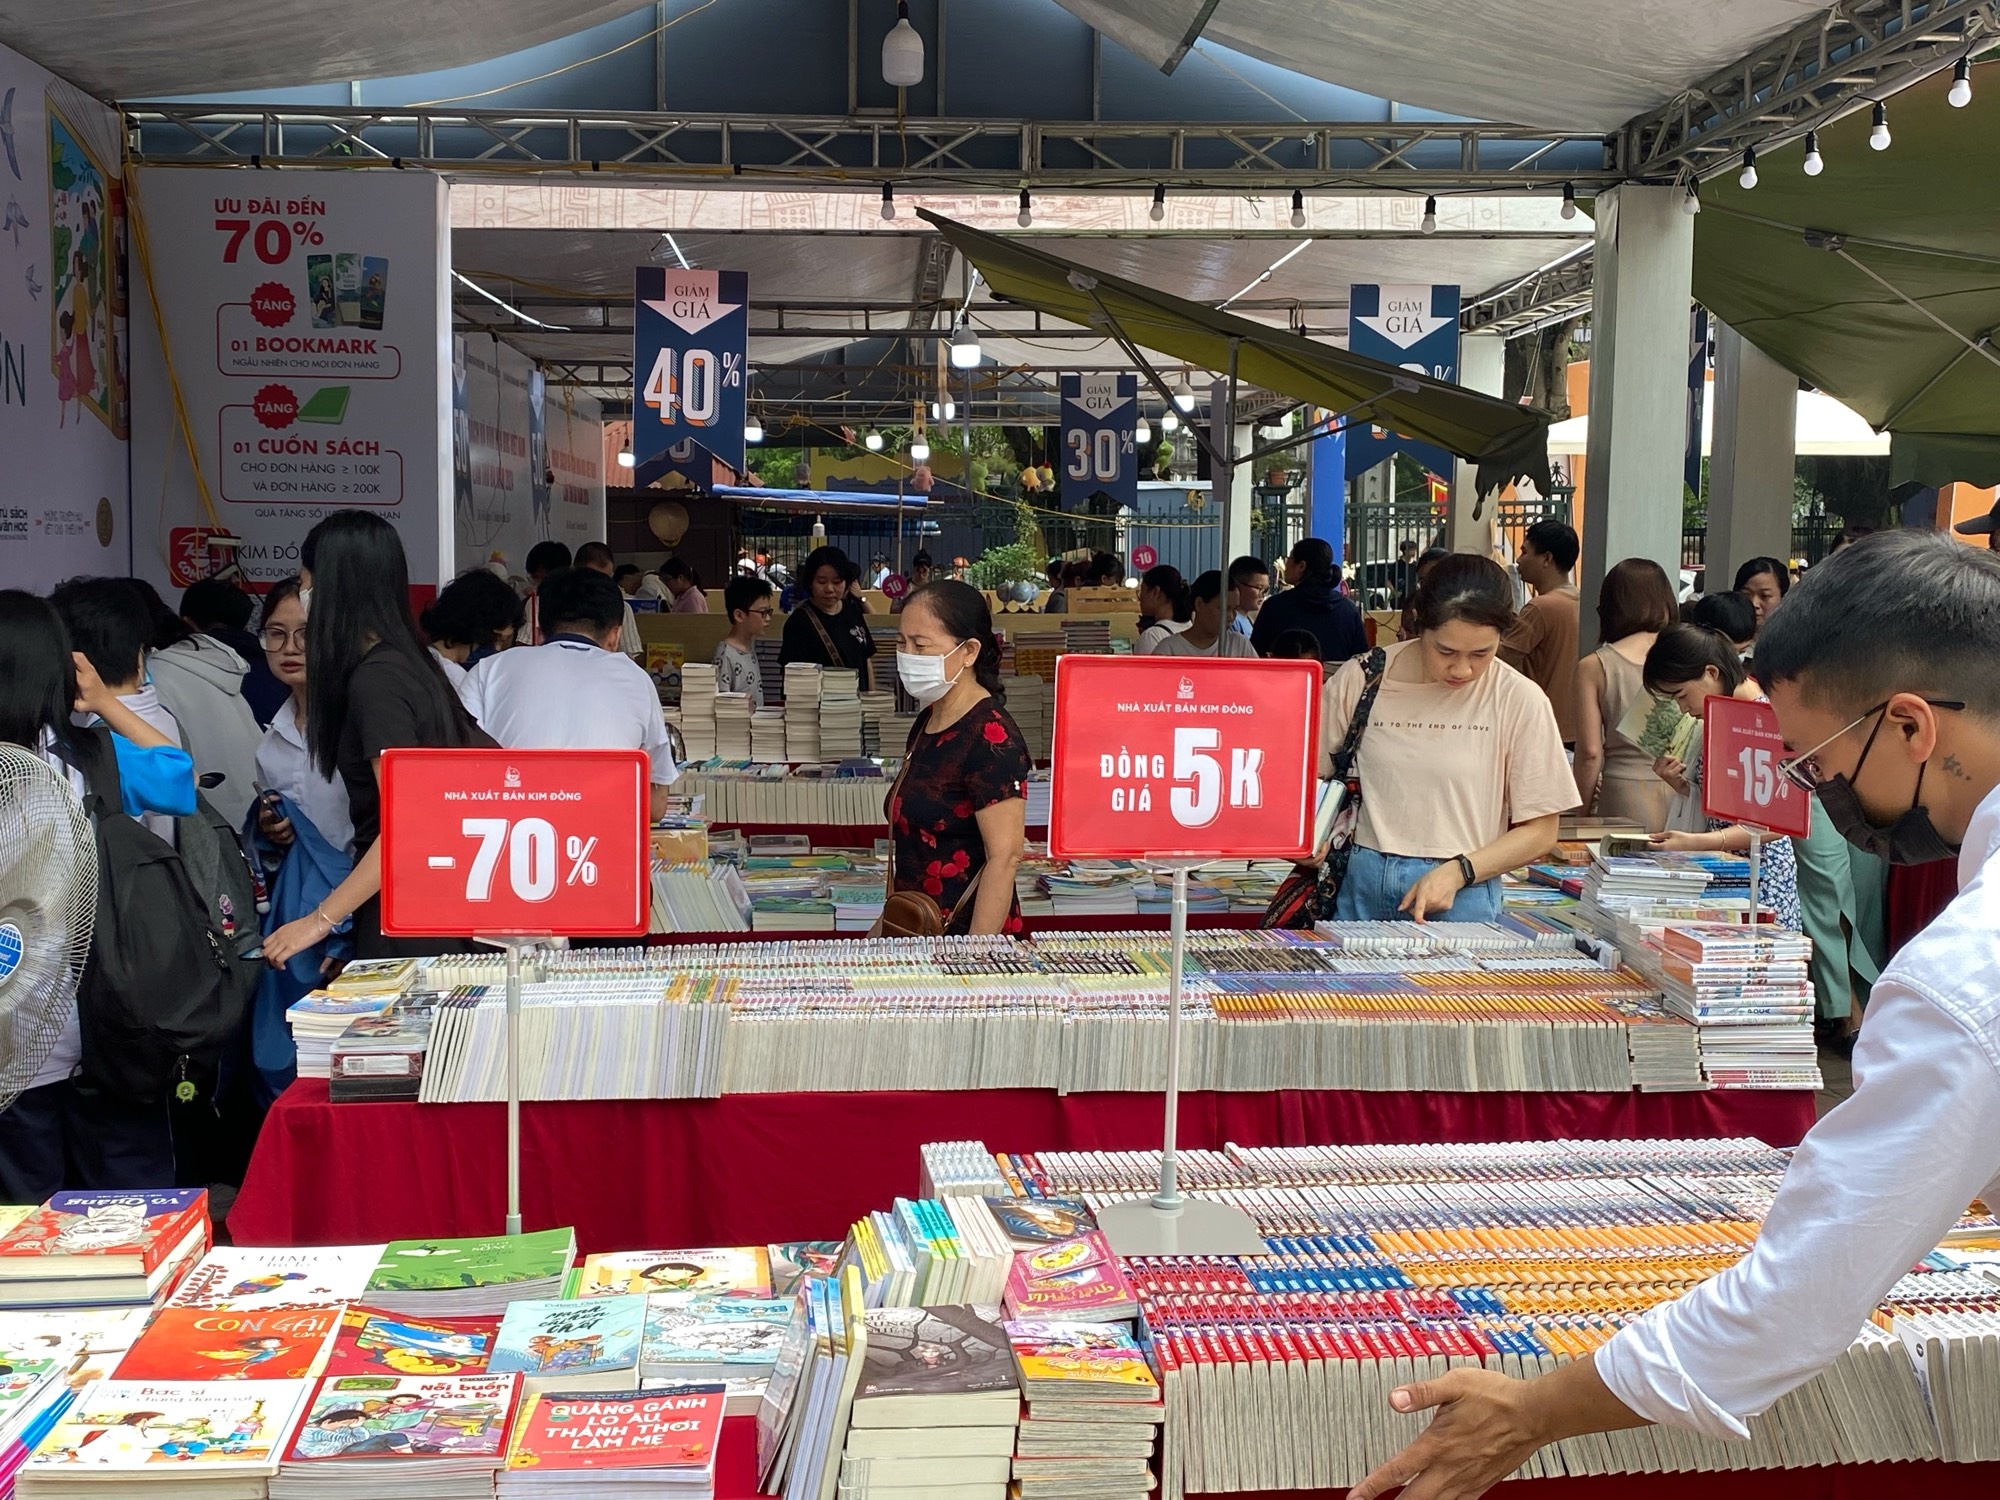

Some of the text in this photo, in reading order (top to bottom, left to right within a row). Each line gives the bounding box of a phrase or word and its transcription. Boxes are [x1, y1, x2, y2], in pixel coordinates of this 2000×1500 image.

[214, 195, 326, 216] ƯU ĐÃI ĐẾN
[215, 219, 324, 265] 70%
[674, 282, 710, 297] GIẢM
[255, 300, 292, 313] TẶNG
[672, 298, 711, 319] GIÁ
[1388, 298, 1422, 312] GIẢM
[1386, 312, 1423, 333] GIÁ
[231, 337, 378, 355] 01 BOOKMARK
[261, 358, 288, 368] NHIÊN
[290, 359, 310, 368] CHO
[353, 358, 380, 370] HÀNG
[643, 347, 742, 427] 40%
[257, 402, 294, 415] TẶNG
[233, 433, 380, 456] 01 CUỐN SÁCH
[1067, 428, 1134, 482] 30%
[240, 463, 267, 473] CHO
[270, 462, 298, 474] ĐƠN
[301, 461, 336, 475] HÀNG
[354, 464, 381, 475] 100K
[253, 480, 268, 491] VÀ
[270, 481, 298, 492] ĐƠN
[301, 480, 336, 493] HÀNG
[353, 483, 381, 494] 200K
[255, 508, 277, 519] QUÀ
[238, 540, 302, 560] KIM ĐỒ
[1135, 551, 1153, 565] -10
[1117, 700, 1254, 715] NHÀ XUẤT BẢN KIM ĐỒNG
[1100, 745, 1165, 779] ĐỒNG
[1170, 727, 1265, 829] 5K
[444, 788, 582, 802] NHÀ XUẤT BẢN KIM ĐỒNG
[1111, 784, 1152, 812] GIÁ
[427, 817, 598, 903] -70%
[714, 1304, 788, 1315] BOSS
[192, 1314, 328, 1333] CON GÁI
[587, 1415, 620, 1427] LO
